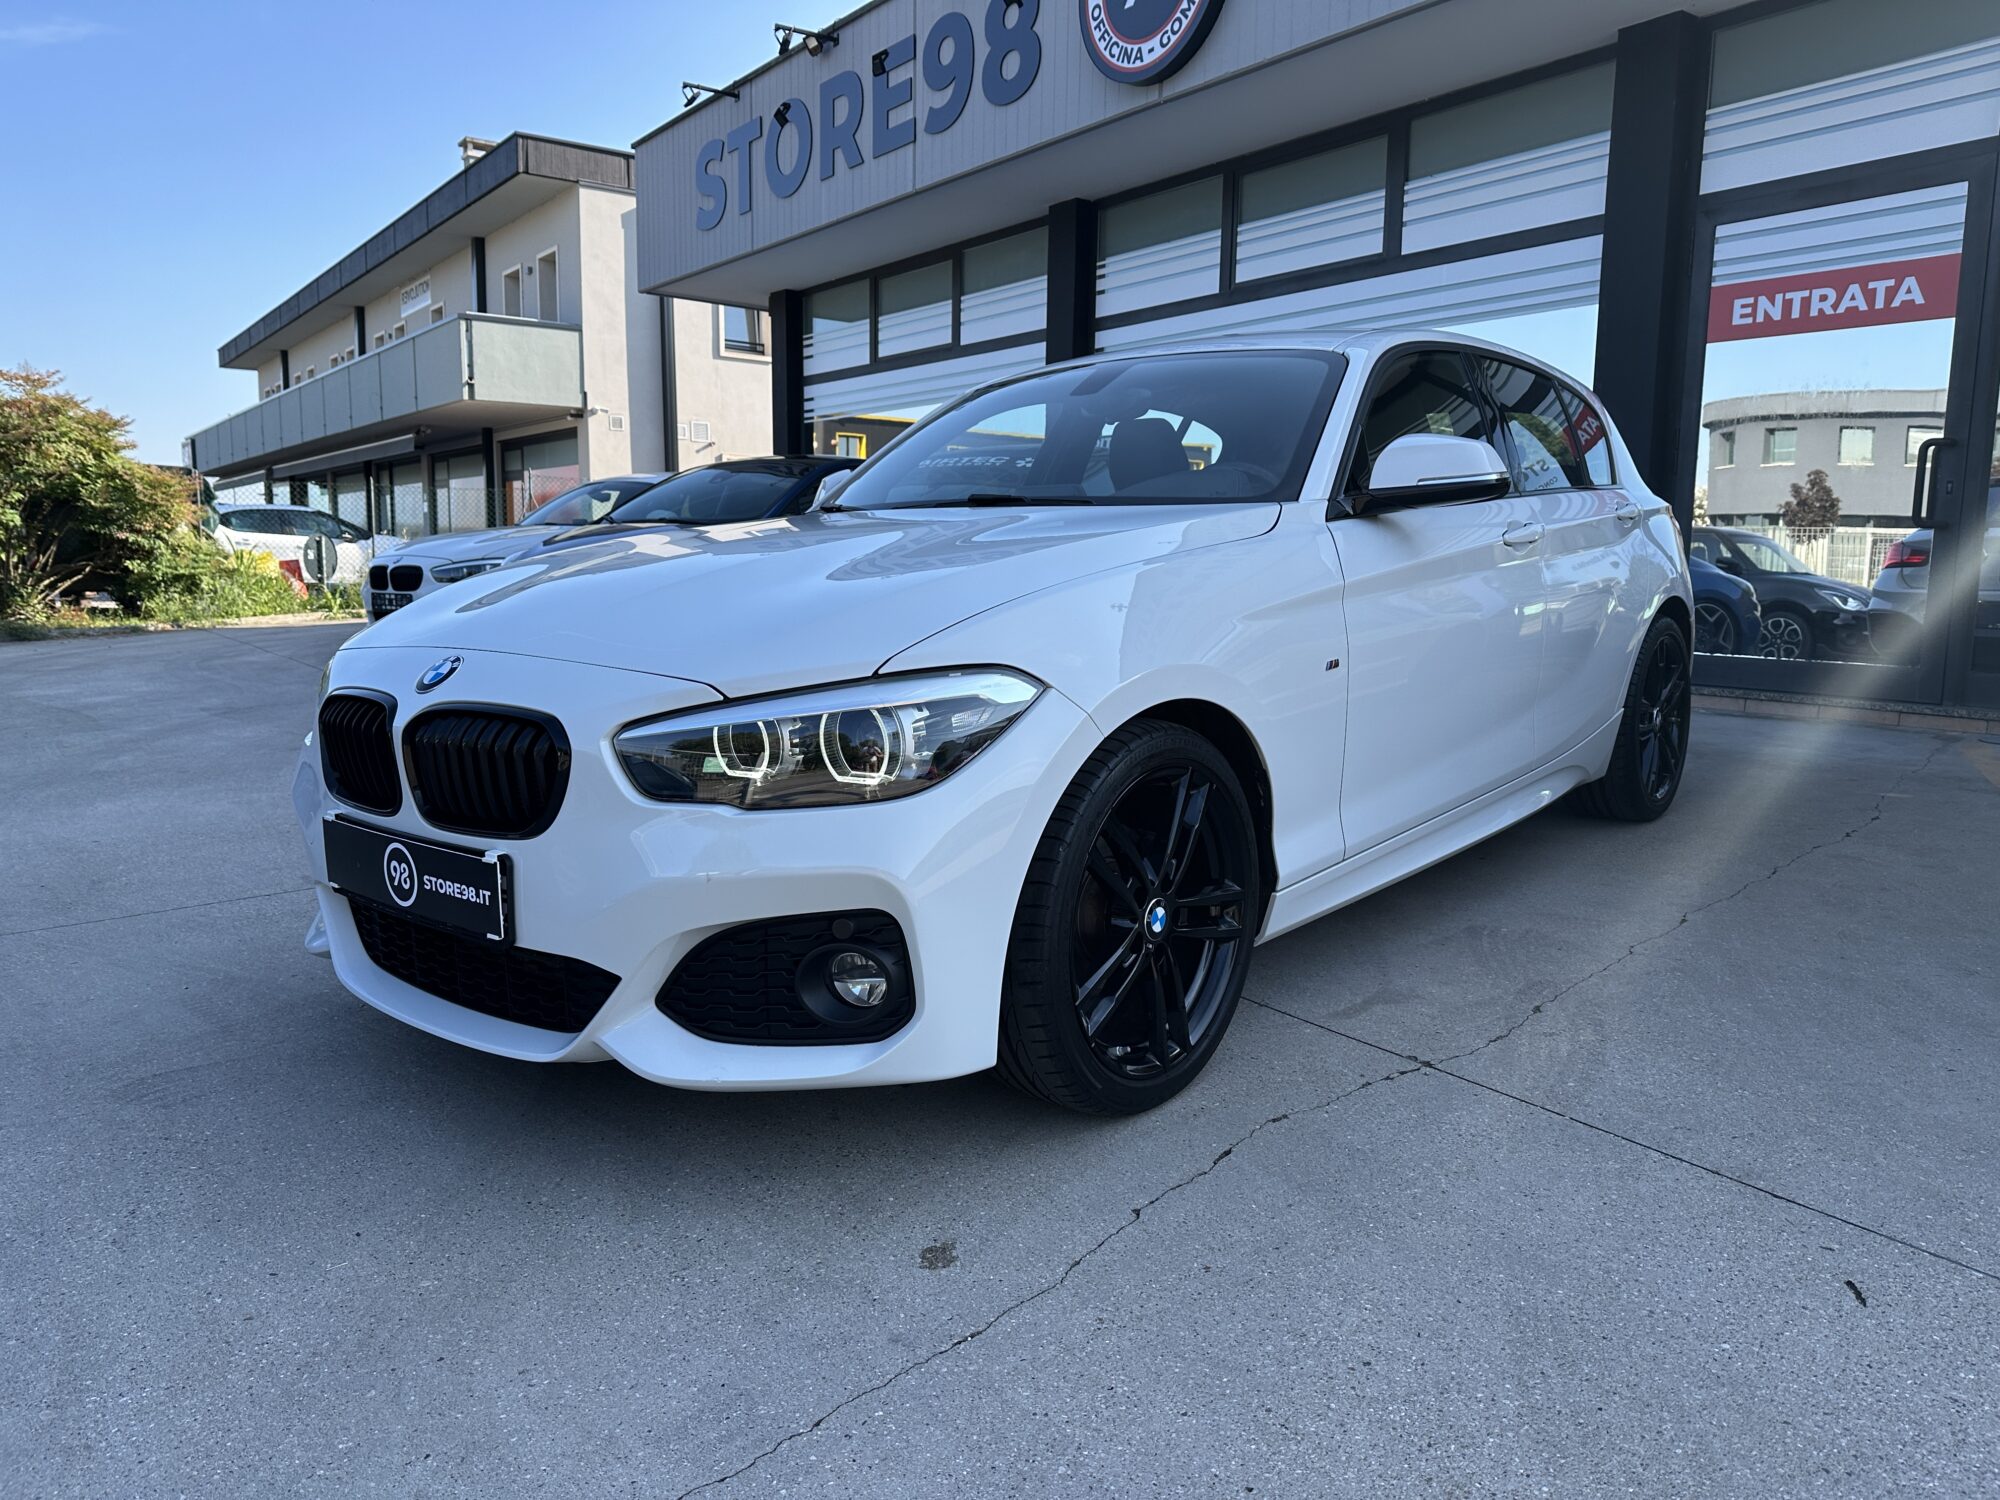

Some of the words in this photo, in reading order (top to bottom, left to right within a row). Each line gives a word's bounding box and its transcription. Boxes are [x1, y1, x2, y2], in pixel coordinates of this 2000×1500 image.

[1090, 3, 1144, 65] OFFICINA
[695, 0, 1042, 231] STORE98
[1731, 275, 1926, 326] ENTRATA
[390, 860, 411, 890] 98
[423, 874, 491, 906] STORE98.IT
